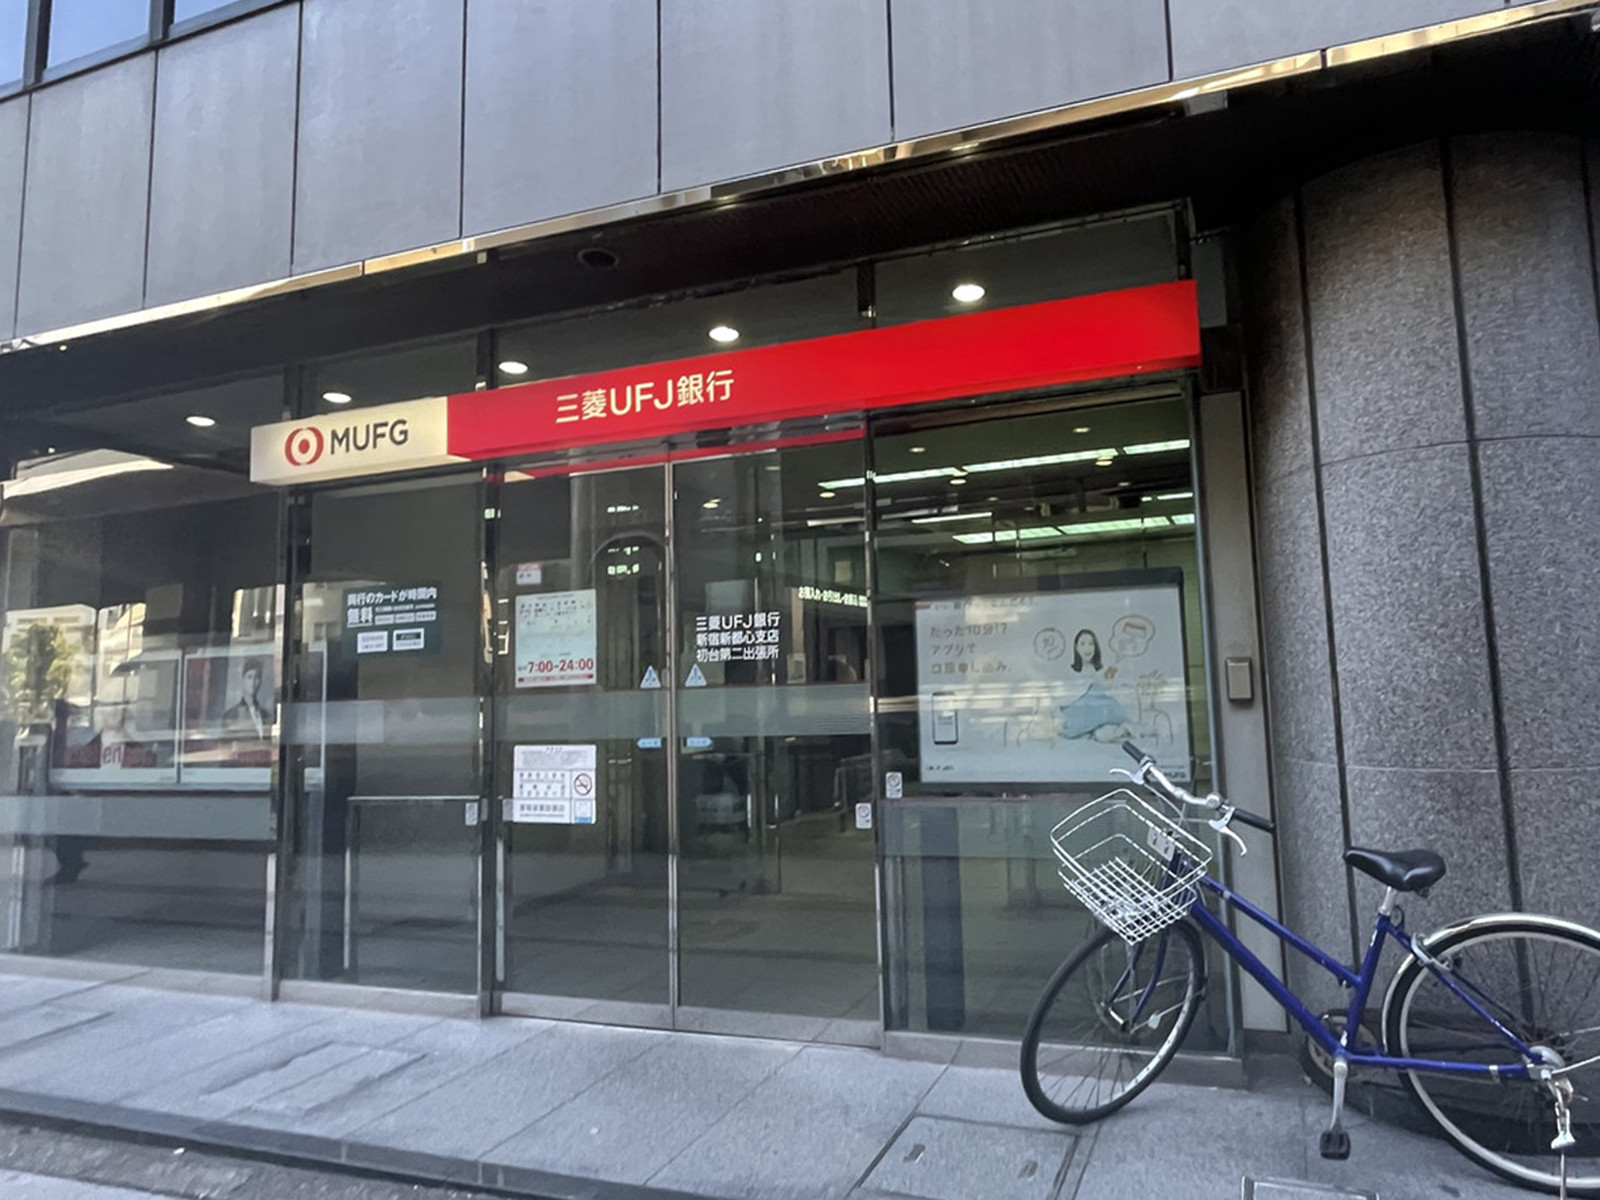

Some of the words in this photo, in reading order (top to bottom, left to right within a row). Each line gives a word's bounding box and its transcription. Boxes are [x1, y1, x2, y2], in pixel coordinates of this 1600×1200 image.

[556, 369, 734, 424] 三菱UFJ銀行
[330, 419, 408, 455] MUFG
[696, 611, 780, 631] 三菱UFJ銀行
[696, 629, 779, 646] 新宿新都心支店
[696, 645, 779, 662] 初台第二出張所
